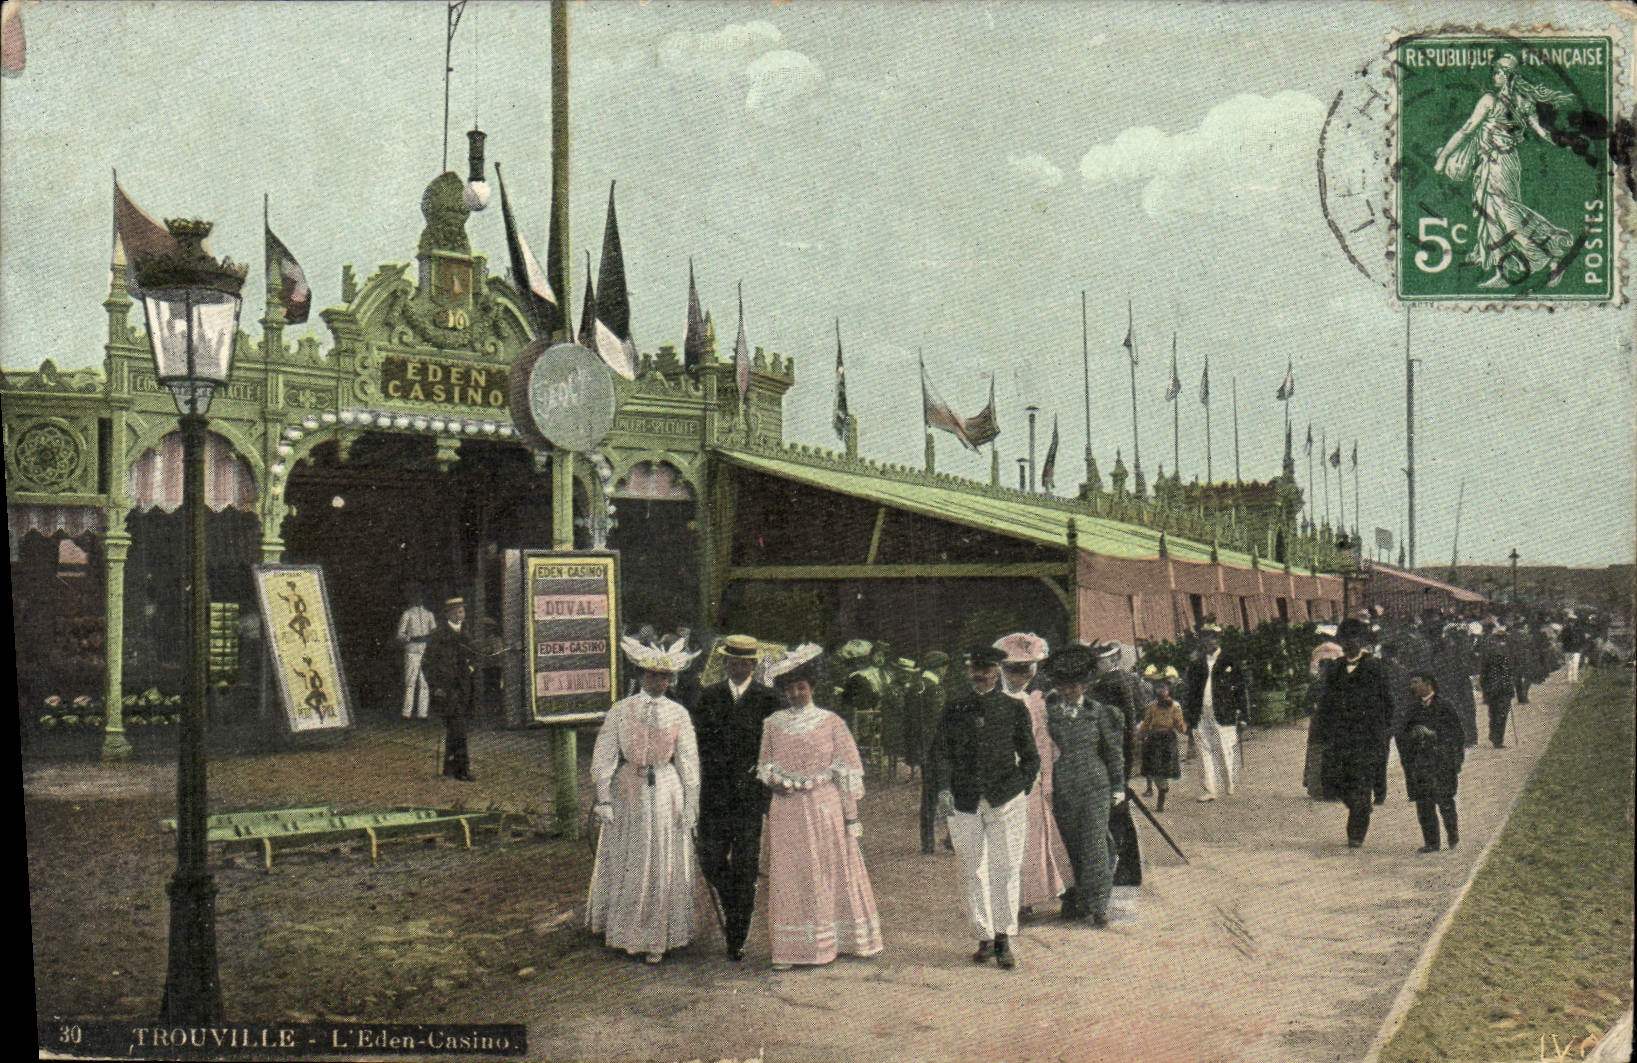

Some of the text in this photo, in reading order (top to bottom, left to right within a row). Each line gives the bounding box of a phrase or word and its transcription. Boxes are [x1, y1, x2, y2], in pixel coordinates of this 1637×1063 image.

[1522, 48, 1602, 69] FRANÇAISE
[407, 362, 486, 387] EDEN
[388, 380, 503, 407] CASINO
[538, 566, 602, 577] EDEN CASINO
[545, 601, 594, 615] DUVAL
